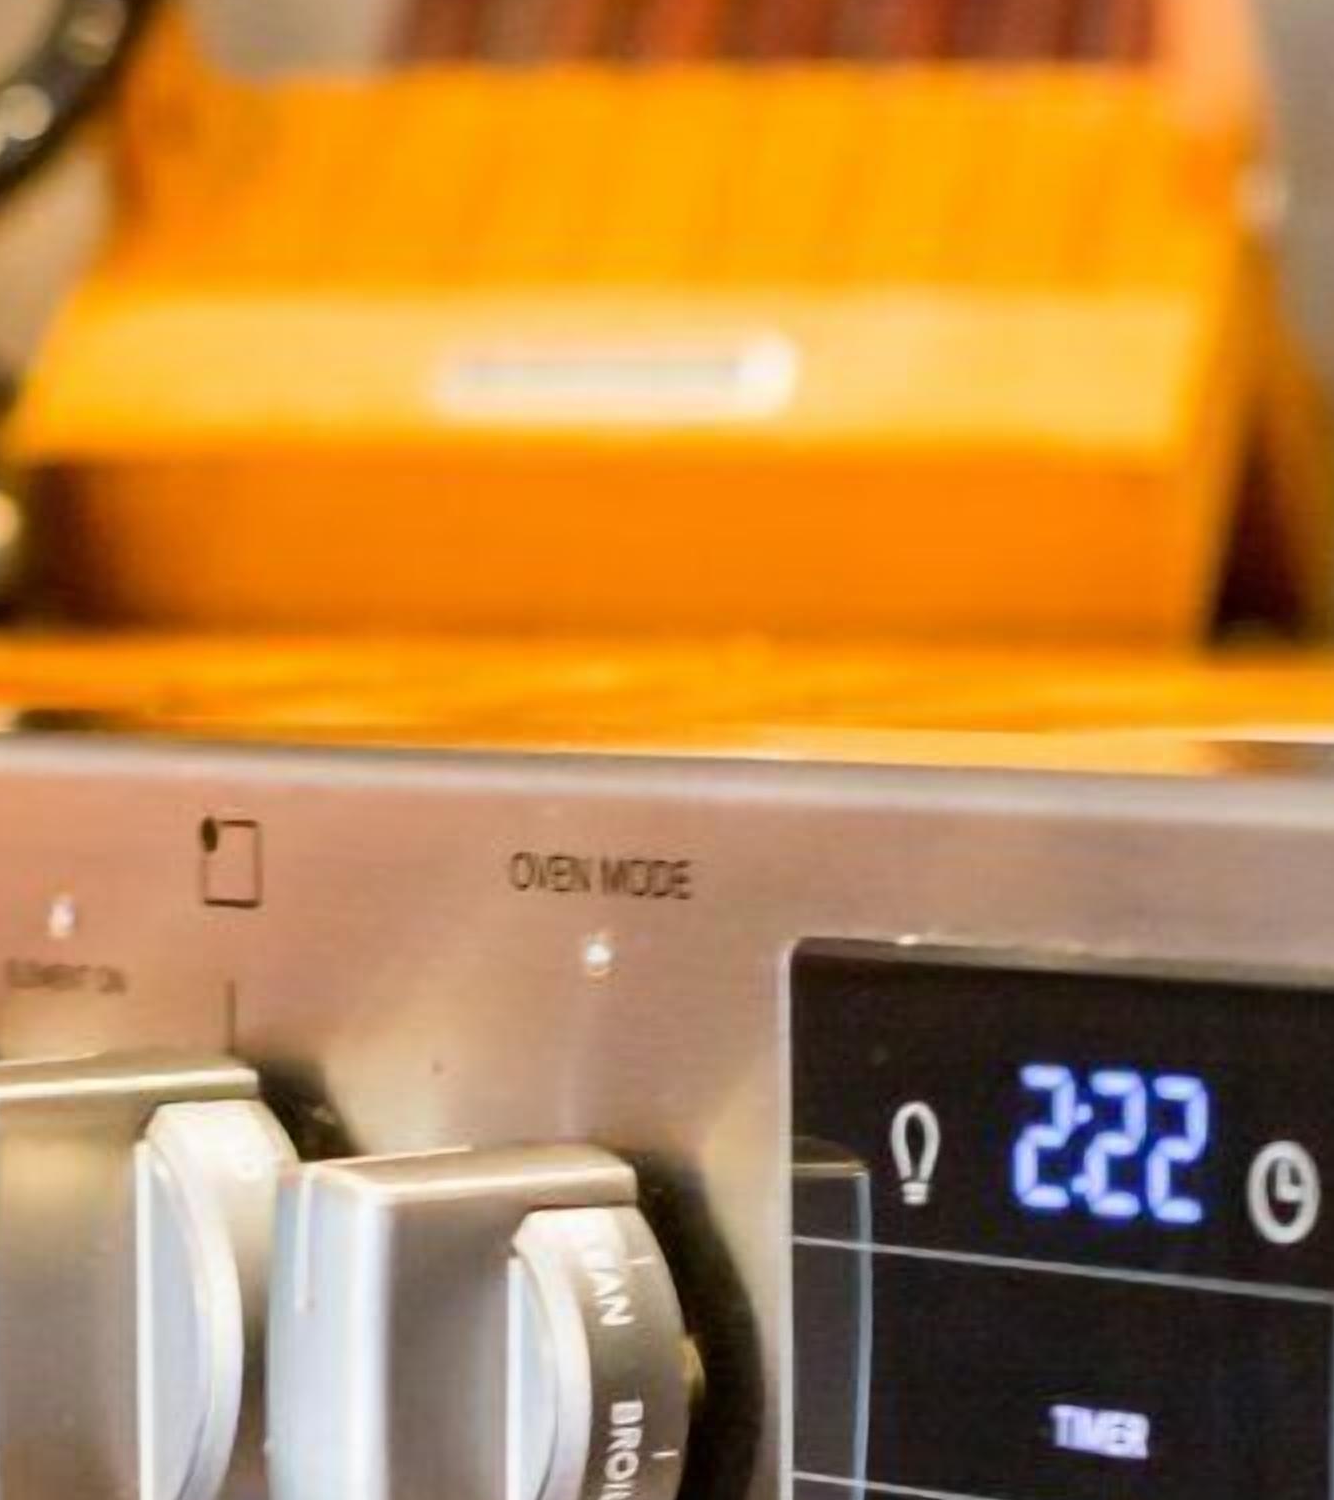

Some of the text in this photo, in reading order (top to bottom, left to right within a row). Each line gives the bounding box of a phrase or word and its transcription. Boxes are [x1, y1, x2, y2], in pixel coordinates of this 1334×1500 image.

[509, 851, 693, 900] OVEN MODE
[1013, 1063, 1209, 1224] 2:22
[1049, 1403, 1150, 1460] TIMER
